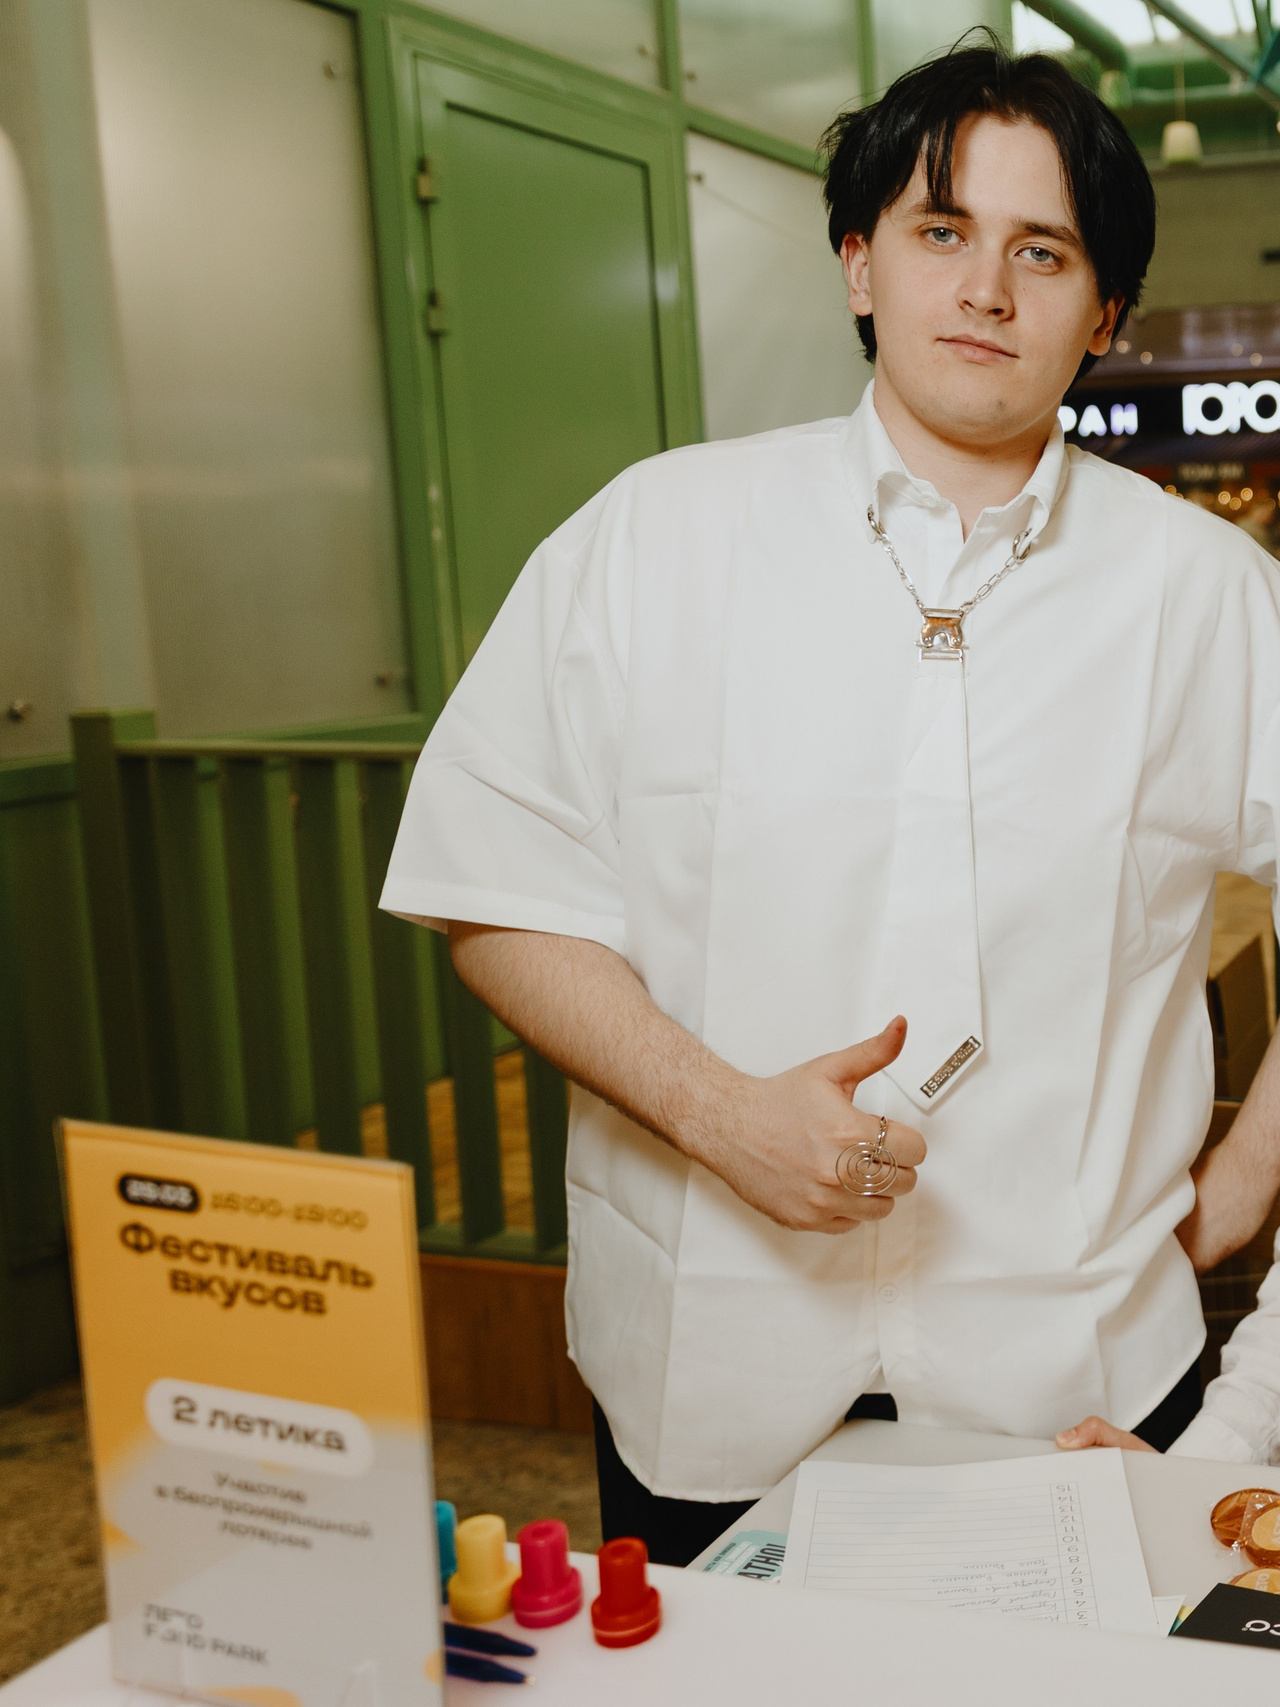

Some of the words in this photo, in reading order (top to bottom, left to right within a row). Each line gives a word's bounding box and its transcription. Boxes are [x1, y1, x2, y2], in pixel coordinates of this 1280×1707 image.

[118, 1221, 376, 1290] Фестиваль
[168, 1268, 328, 1317] вкусов
[172, 1395, 199, 1425] 2
[1254, 1573, 1270, 1592] ЕТО
